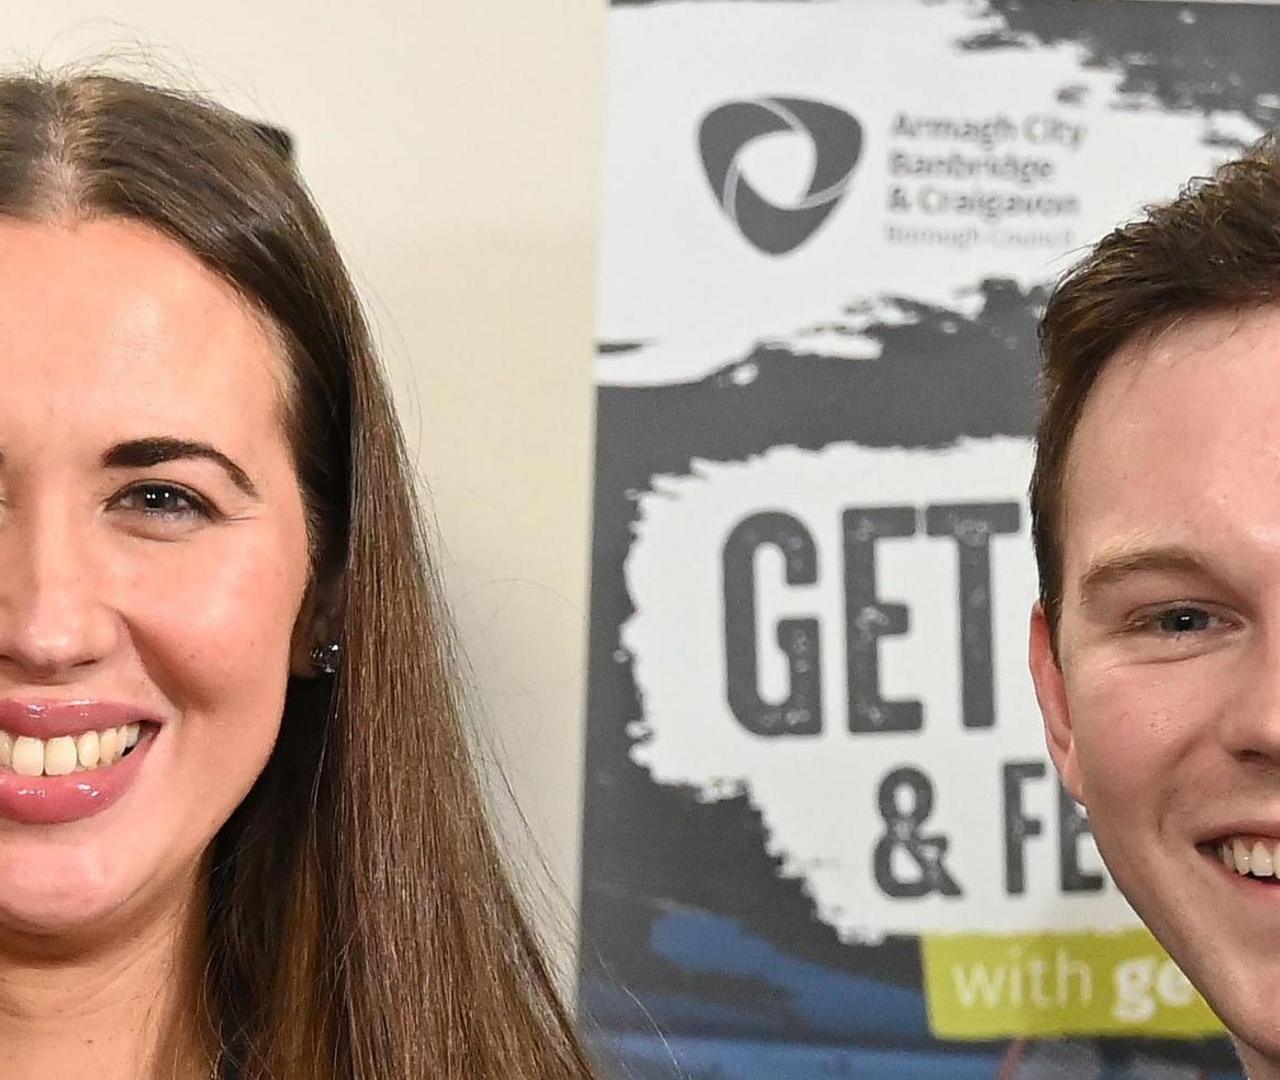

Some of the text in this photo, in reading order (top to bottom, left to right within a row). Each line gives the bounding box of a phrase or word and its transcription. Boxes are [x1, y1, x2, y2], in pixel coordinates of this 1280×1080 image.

[890, 112, 1088, 150] Armagh City
[889, 150, 1055, 184] Banbridge
[888, 185, 1079, 222] & Craigavon
[722, 501, 1021, 737] GET
[872, 762, 1106, 898] & FE
[951, 945, 1195, 1024] with ge
